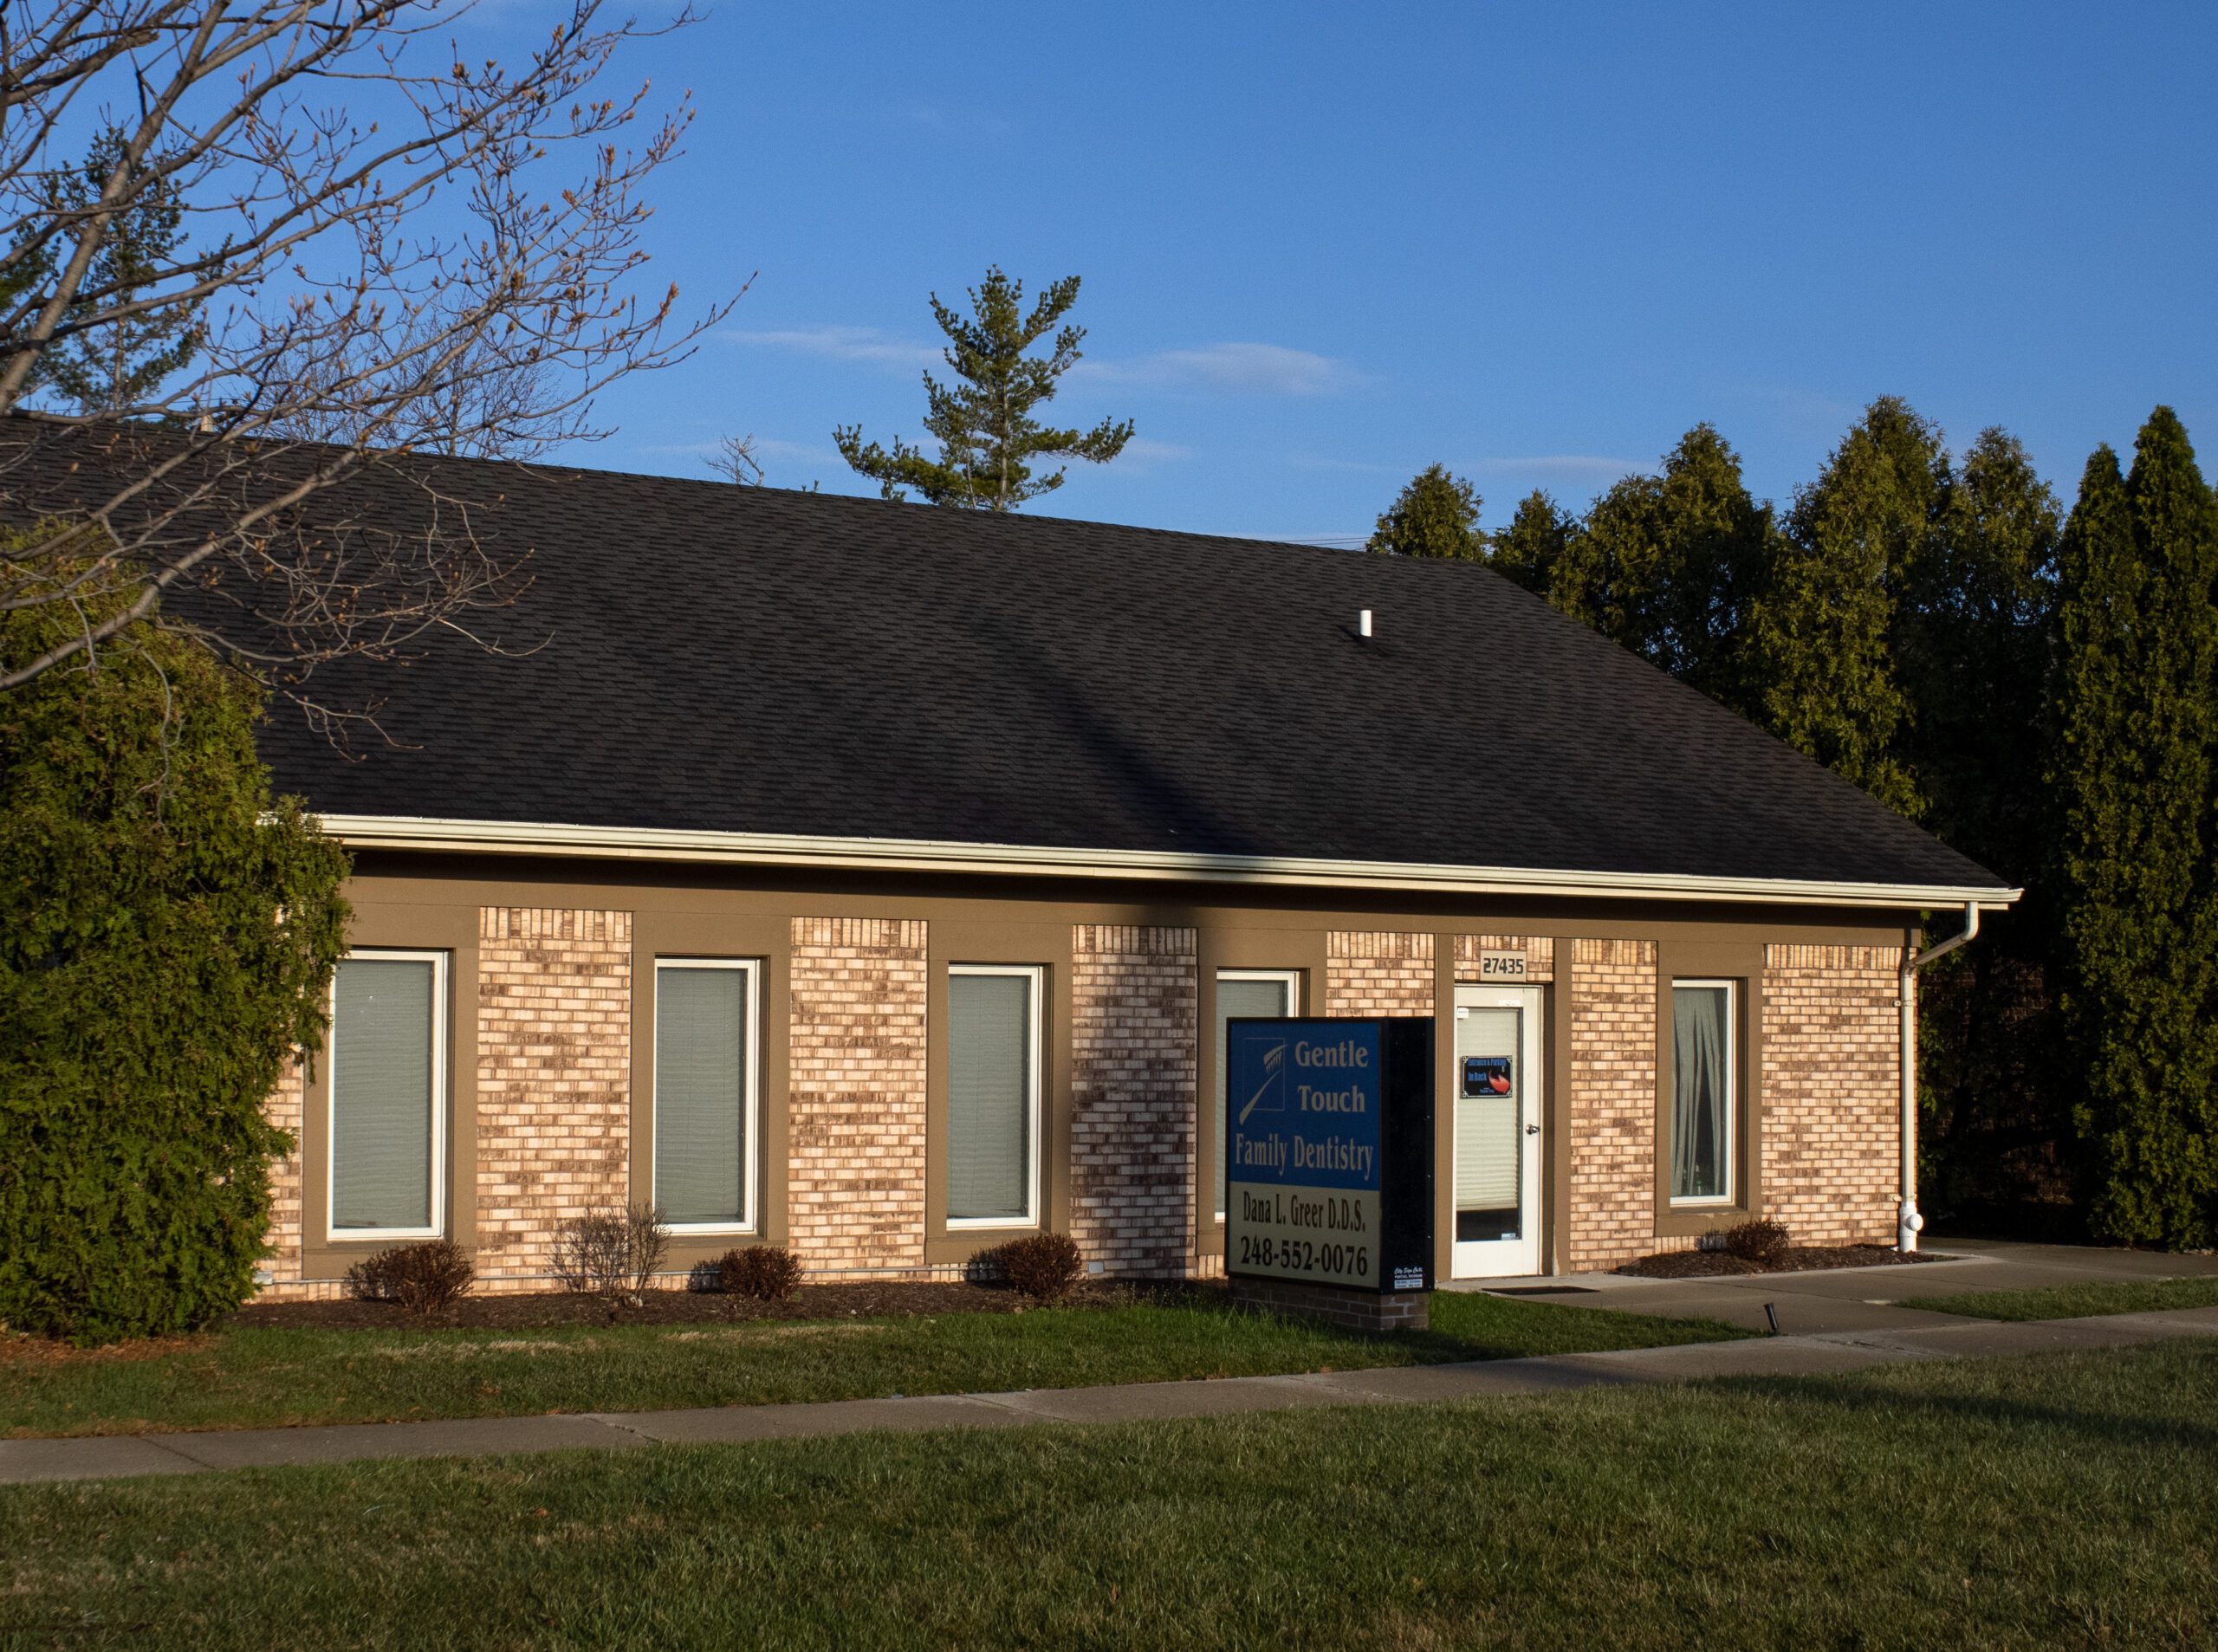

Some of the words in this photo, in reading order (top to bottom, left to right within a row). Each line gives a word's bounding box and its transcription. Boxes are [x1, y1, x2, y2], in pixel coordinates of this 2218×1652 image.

[1482, 957, 1524, 975] 27435
[1294, 1040, 1369, 1067] Gentle
[1297, 1085, 1366, 1113] Touch
[1235, 1132, 1287, 1177] Family
[1294, 1135, 1373, 1182] Dentistry
[1242, 1190, 1272, 1224] Dana
[1275, 1193, 1287, 1226] L.
[1290, 1194, 1325, 1228] Greer
[1328, 1197, 1366, 1233] D.D.S.
[1240, 1234, 1368, 1277] 248-552-0076
